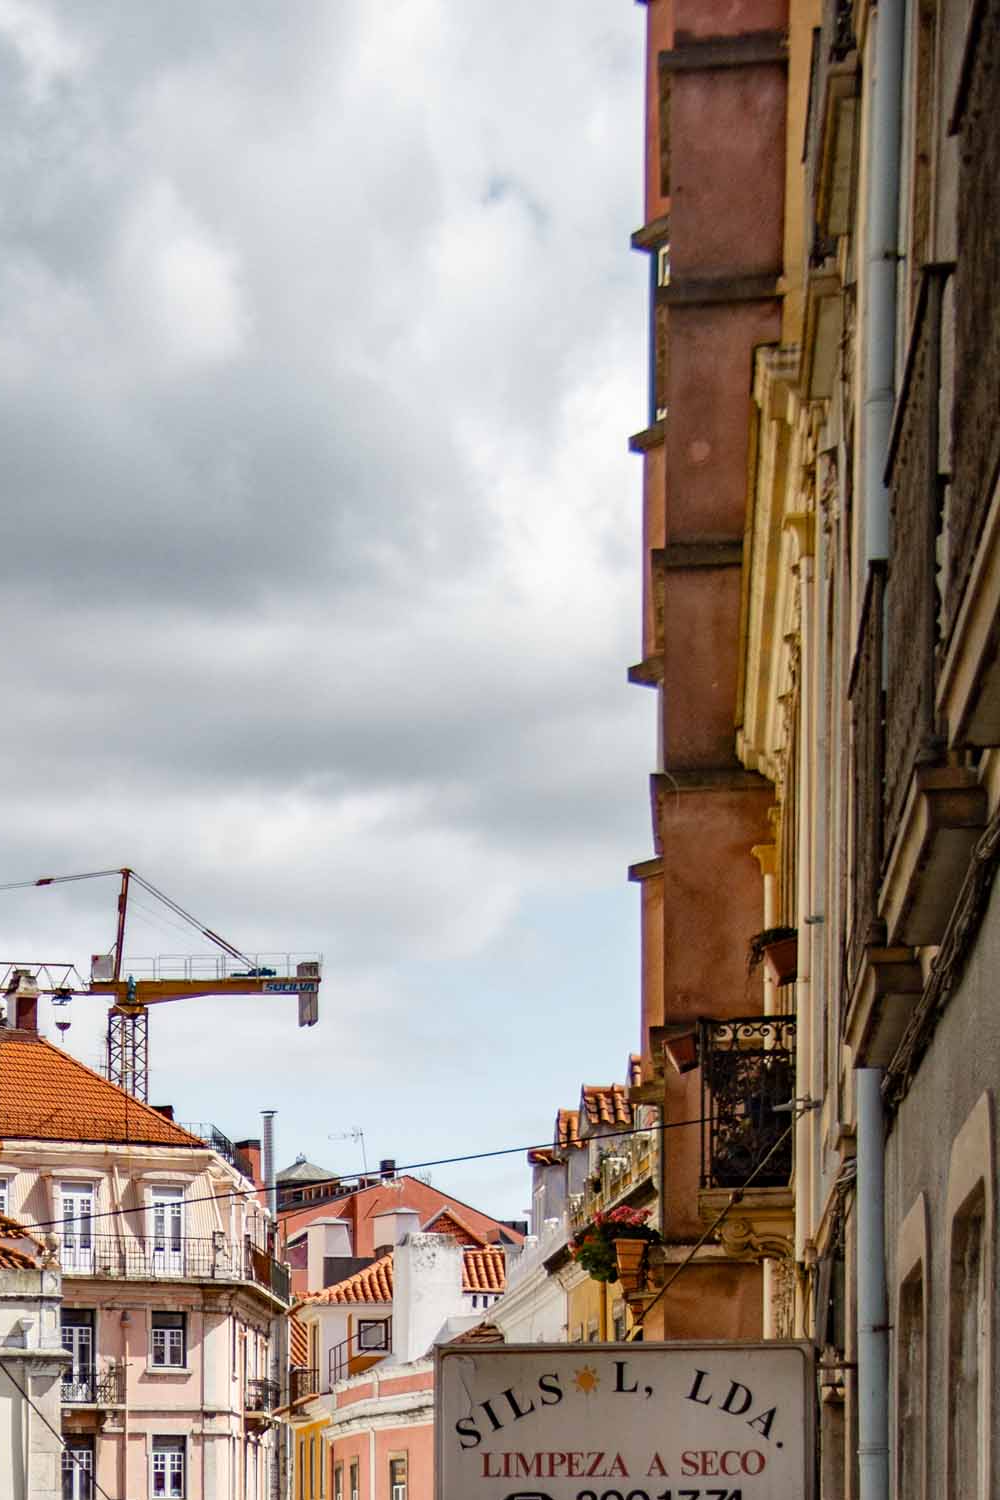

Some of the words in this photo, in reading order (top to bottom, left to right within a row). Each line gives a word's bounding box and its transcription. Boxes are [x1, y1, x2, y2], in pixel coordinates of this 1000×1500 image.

[684, 1369, 785, 1449] LDA.
[480, 1451, 629, 1478] LIMPEZA
[647, 1451, 669, 1478] A
[681, 1449, 766, 1477] SECO
